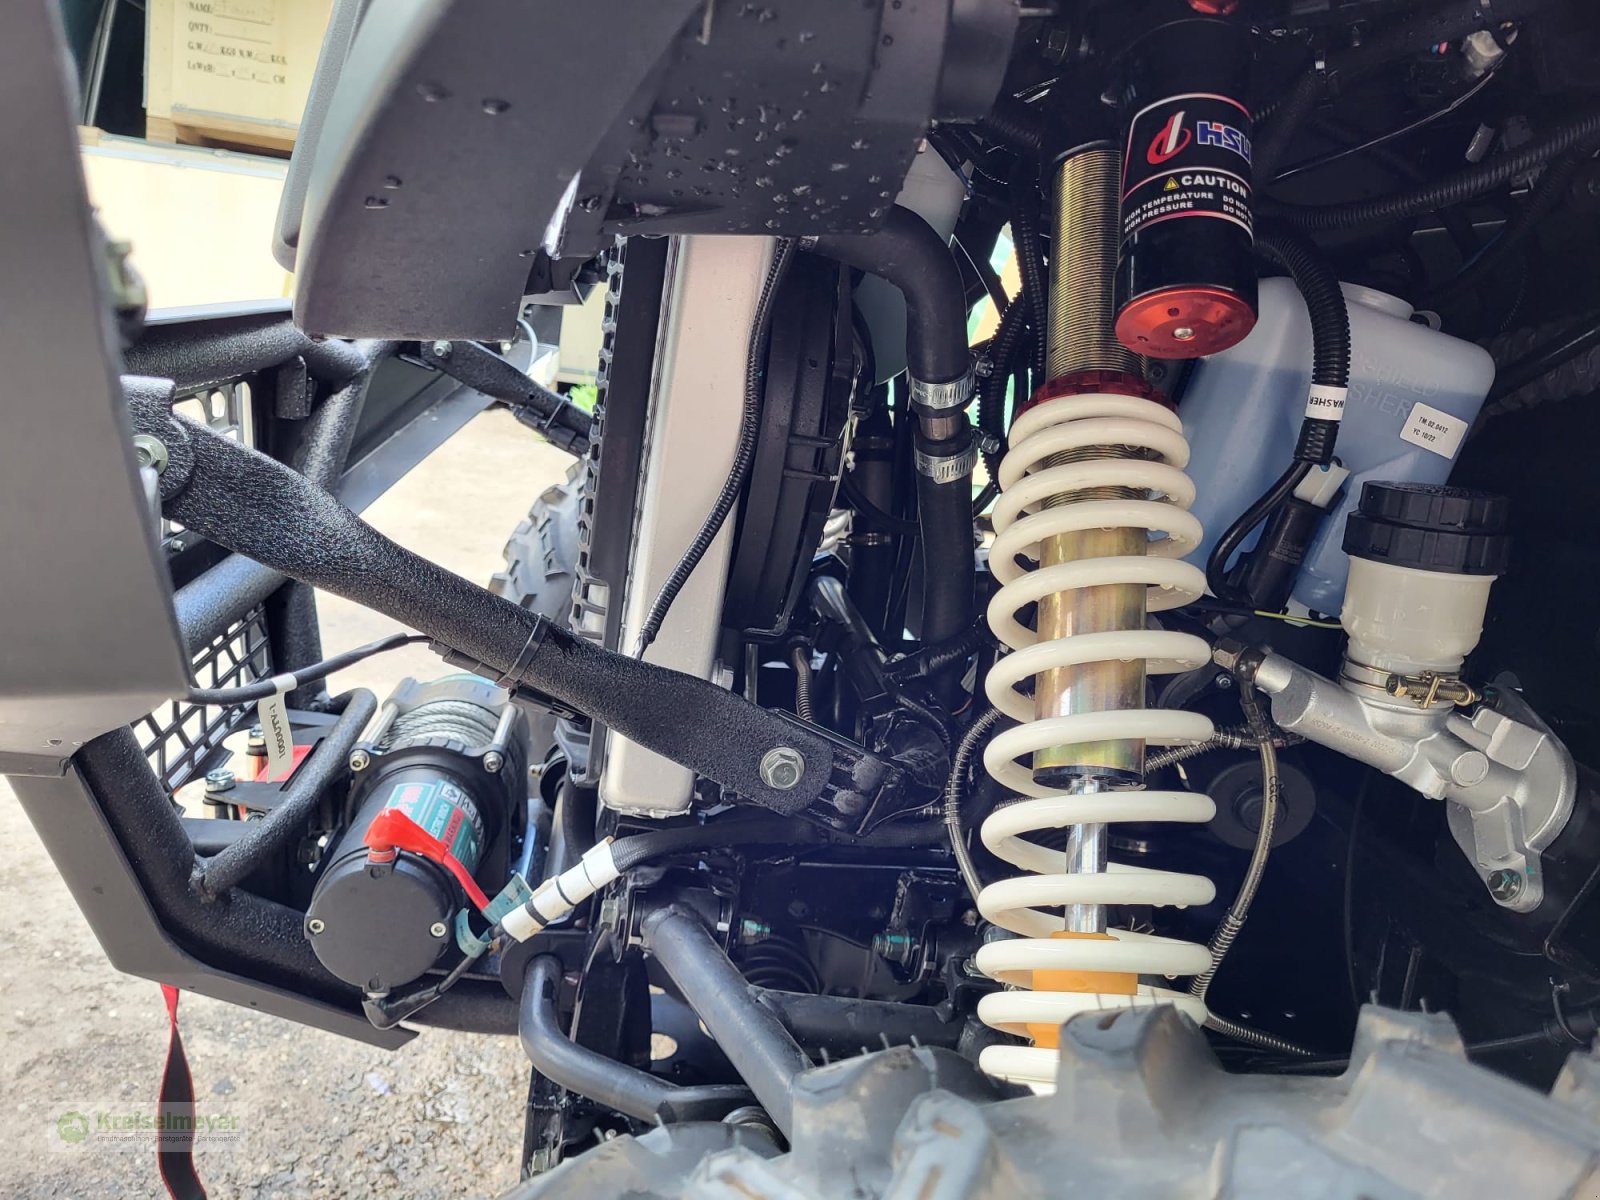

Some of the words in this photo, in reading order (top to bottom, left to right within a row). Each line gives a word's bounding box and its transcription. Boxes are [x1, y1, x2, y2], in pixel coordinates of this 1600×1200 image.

[1181, 175, 1247, 198] CAUTION
[1125, 207, 1141, 225] HIGH
[1143, 191, 1214, 210] TEMPERATURE
[1223, 195, 1234, 204] DO
[1235, 200, 1247, 212] NOT
[1223, 204, 1234, 214] DO
[1125, 217, 1141, 233] HIGH
[1142, 201, 1193, 220] PRESSURE
[1309, 396, 1345, 408] WASHER
